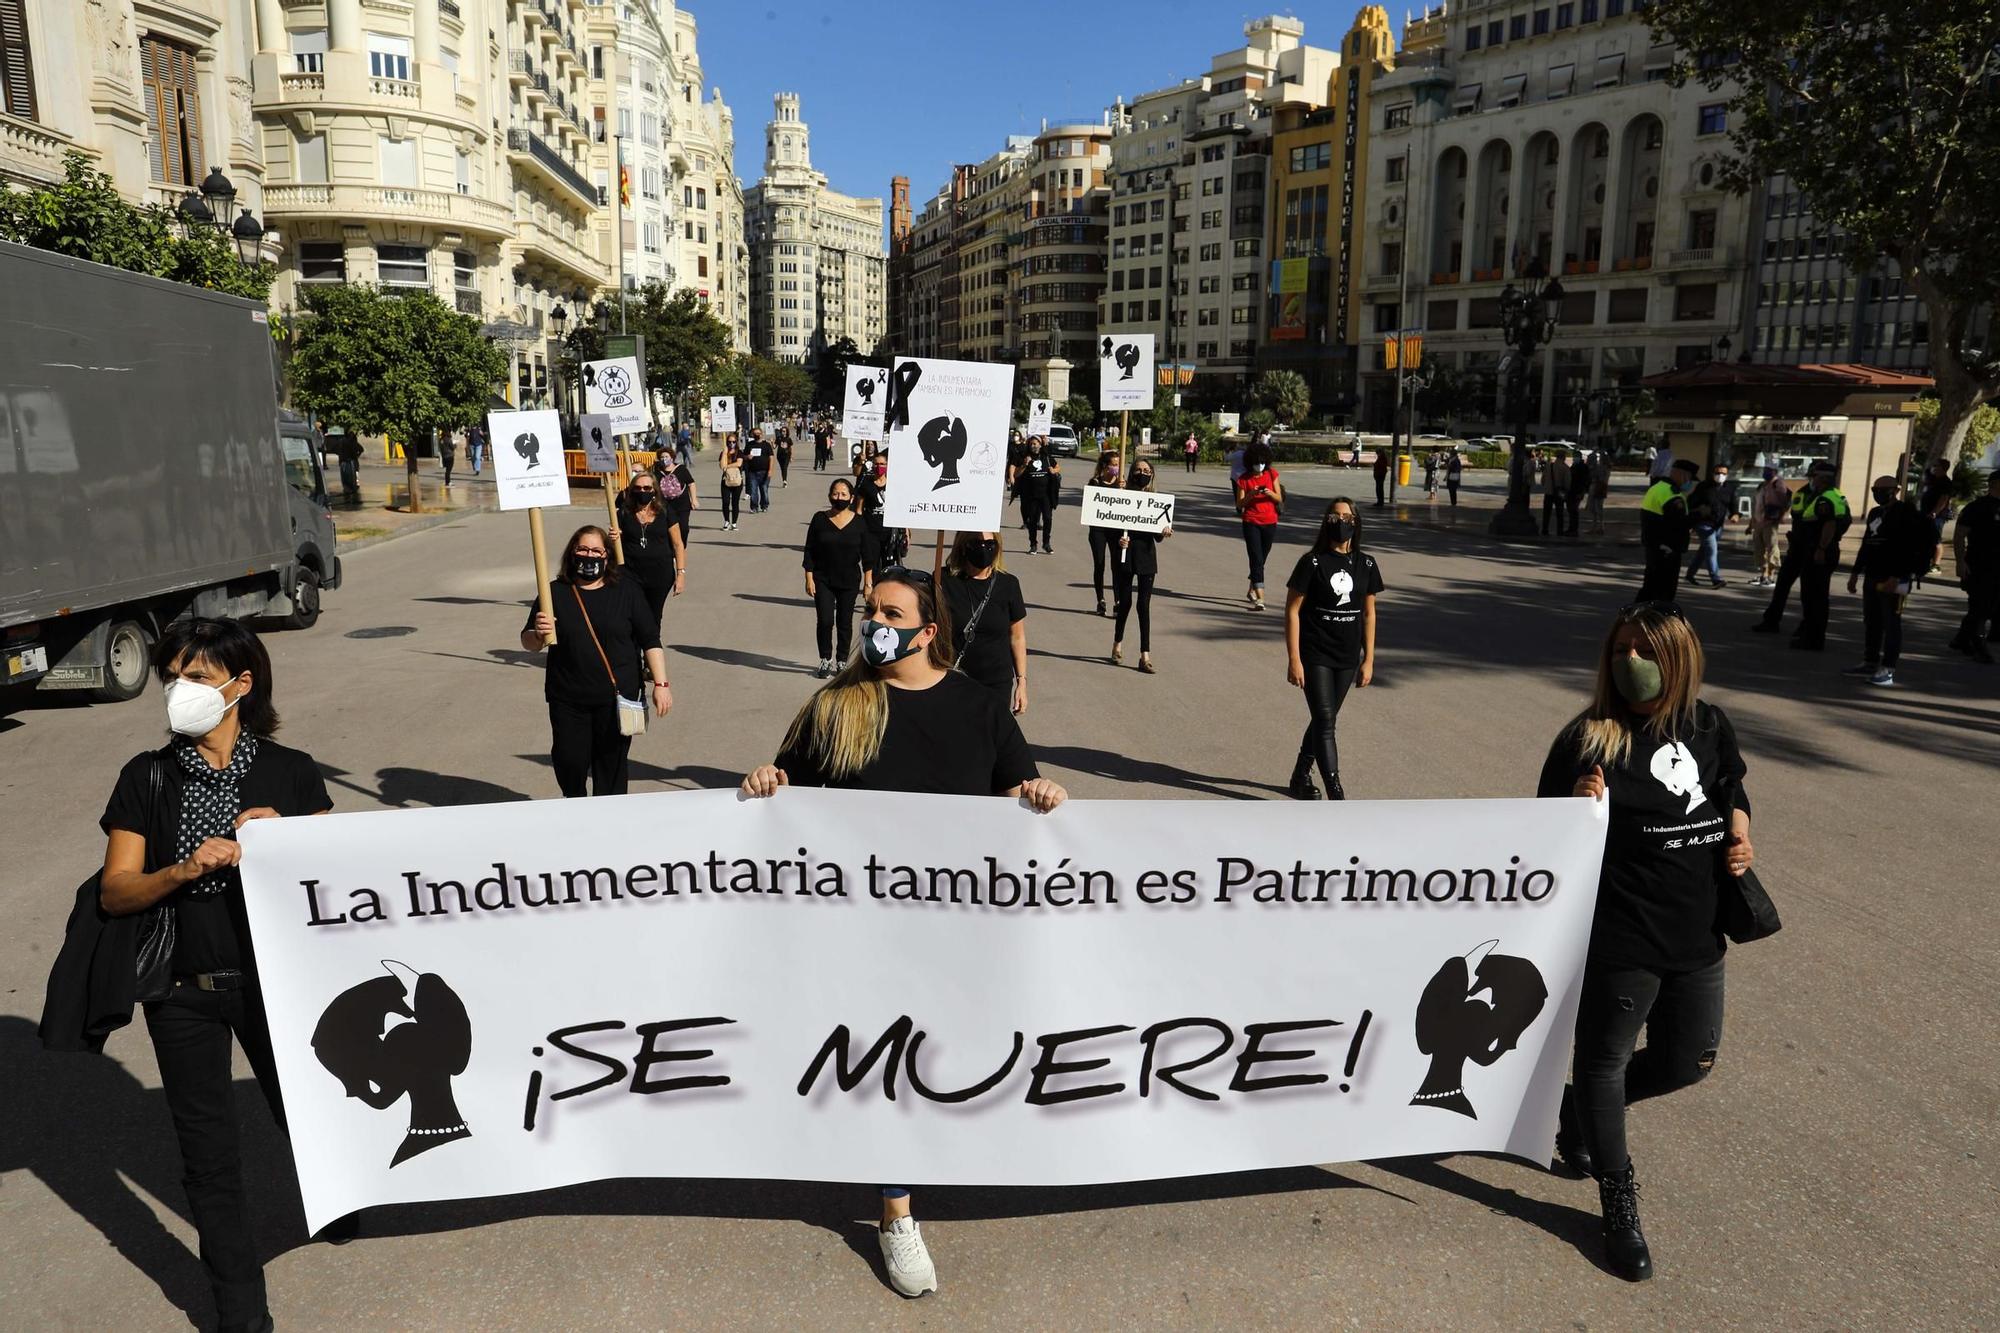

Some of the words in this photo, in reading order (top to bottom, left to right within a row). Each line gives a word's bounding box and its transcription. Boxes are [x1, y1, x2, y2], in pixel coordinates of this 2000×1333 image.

[931, 503, 977, 514] MUERE!!!
[1093, 492, 1131, 506] Amparo
[1136, 499, 1142, 509] y
[1096, 509, 1158, 525] Indumentaria
[1653, 823, 1691, 832] Indumentaria
[1691, 819, 1711, 829] también
[1663, 839, 1682, 850] ¡SE
[300, 879, 387, 926] La
[401, 847, 848, 918] Indumentaria
[863, 853, 1119, 908] también
[1136, 868, 1197, 903] es
[1213, 855, 1555, 904] Patrimonio
[523, 1016, 738, 1132] ¡SE
[796, 1009, 1373, 1106] MUERE!
